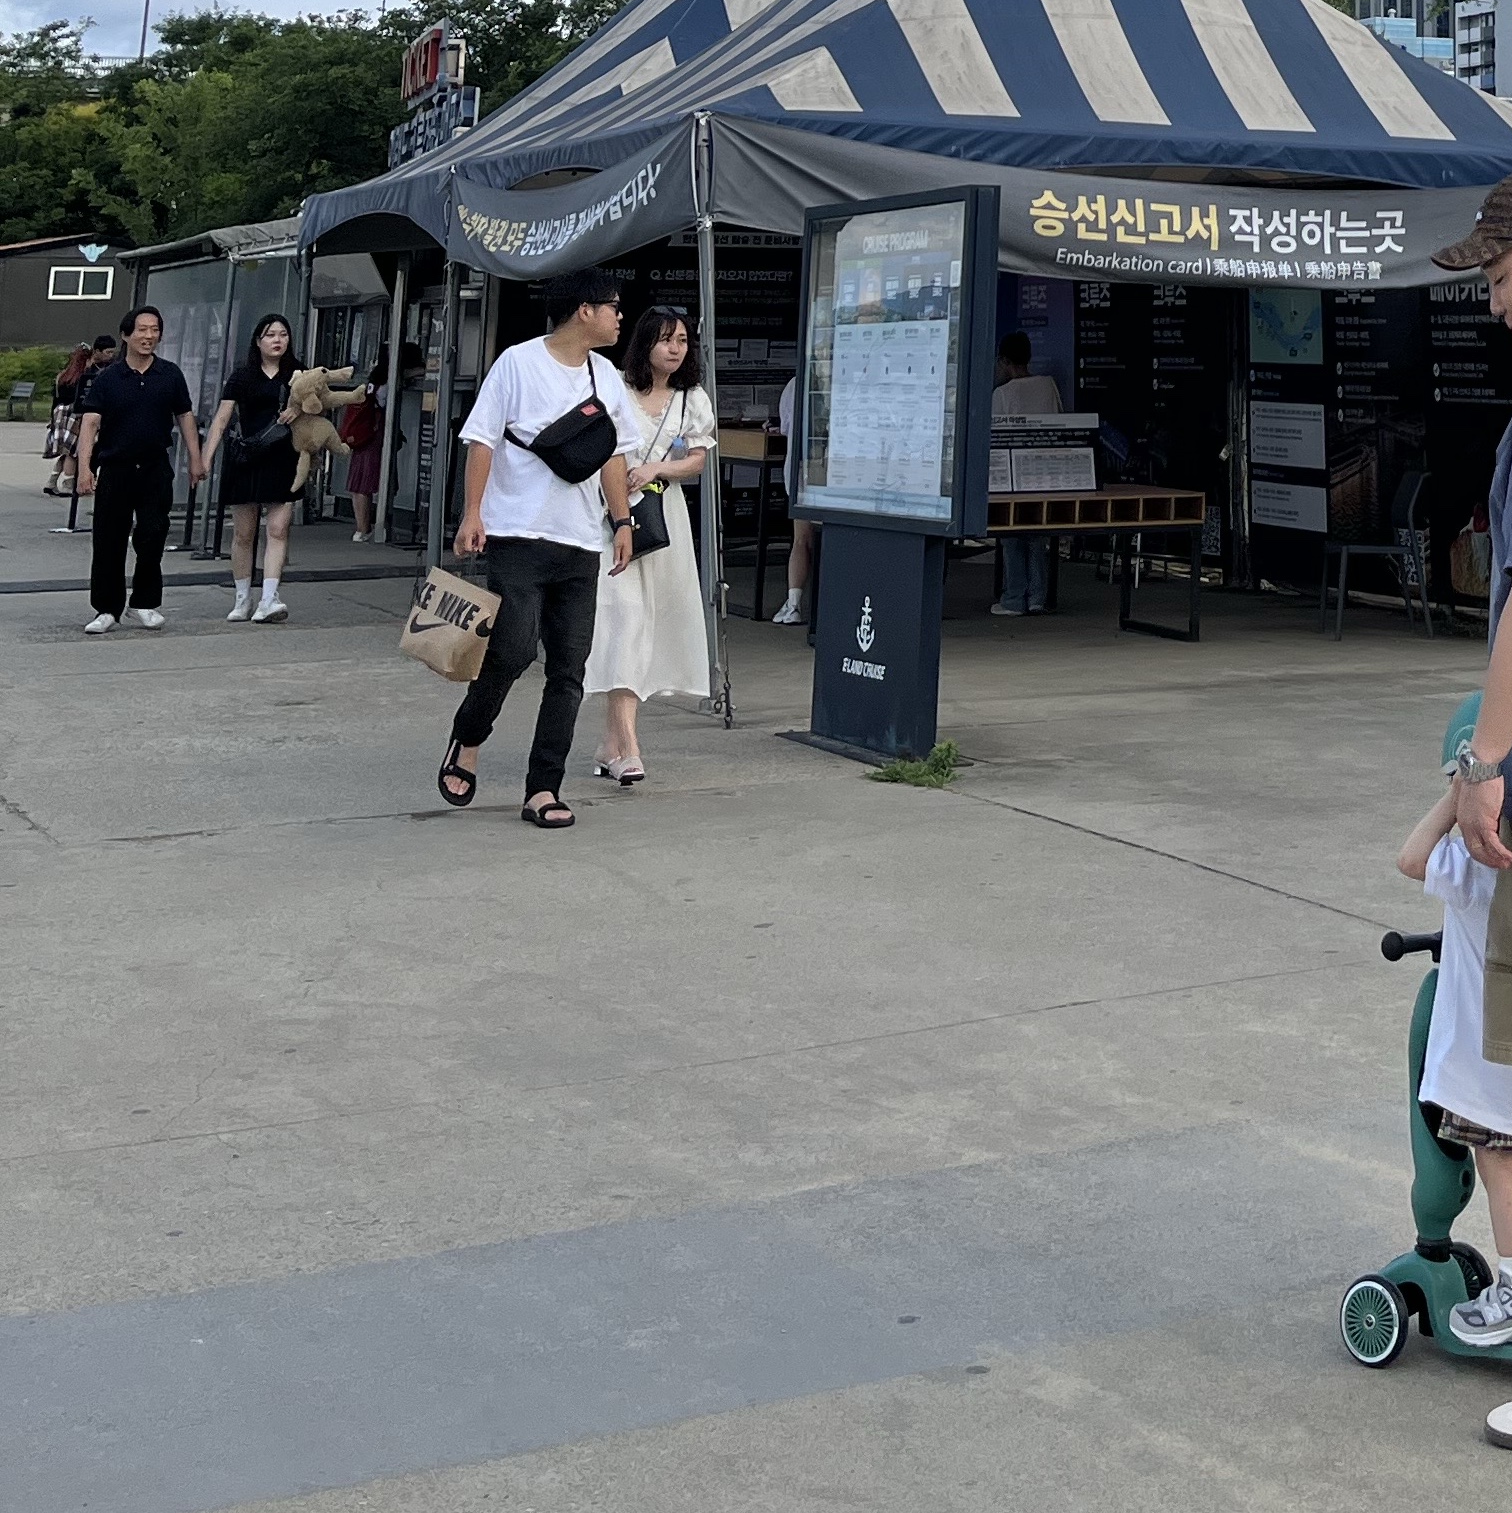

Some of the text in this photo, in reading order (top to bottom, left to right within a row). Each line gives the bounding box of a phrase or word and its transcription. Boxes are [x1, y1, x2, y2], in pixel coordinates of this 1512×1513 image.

[500, 221, 527, 256] 모두
[1029, 189, 1406, 255] 승선신고서 작성하는곳
[862, 228, 929, 254] CRUISE PROGRAM
[1055, 247, 1164, 273] Embarkation
[1167, 257, 1203, 275] card
[433, 590, 482, 631] NIKE
